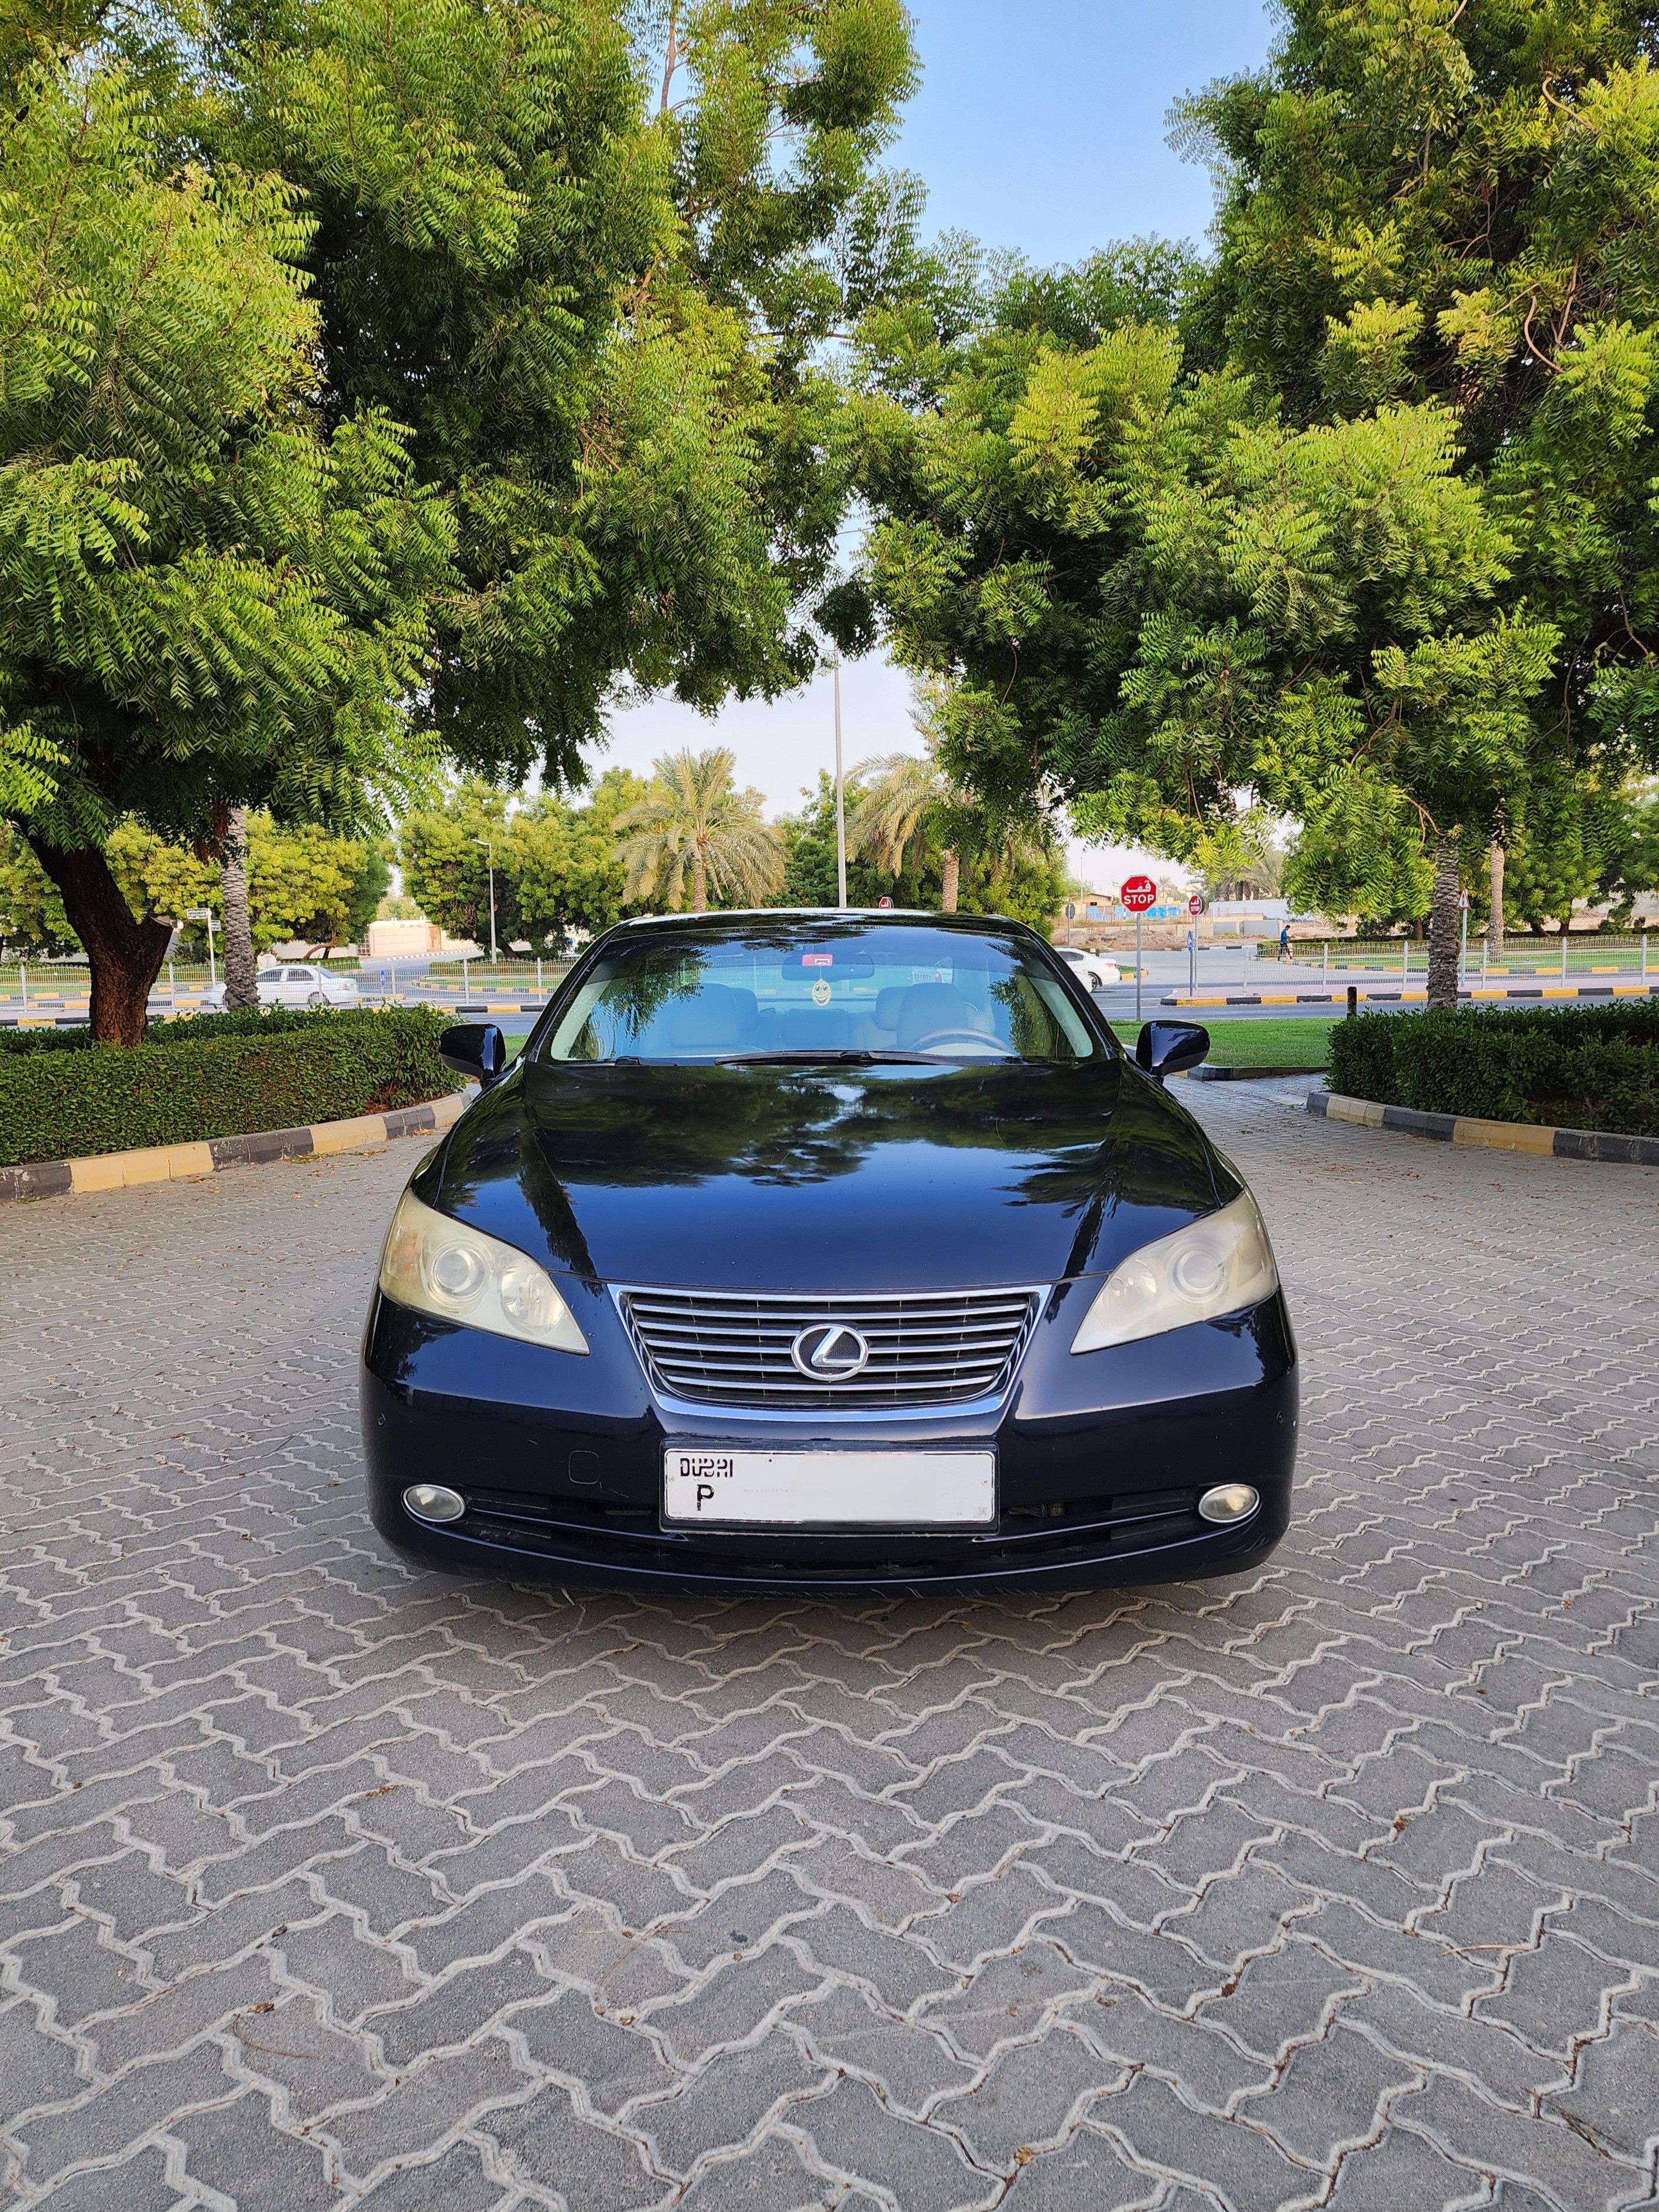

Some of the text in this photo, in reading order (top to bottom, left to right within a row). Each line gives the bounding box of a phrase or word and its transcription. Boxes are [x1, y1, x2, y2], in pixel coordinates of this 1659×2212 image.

[1126, 880, 1151, 893] قف
[1123, 894, 1154, 904] STOP
[680, 1457, 733, 1477] DUBAI
[697, 1484, 715, 1511] P
